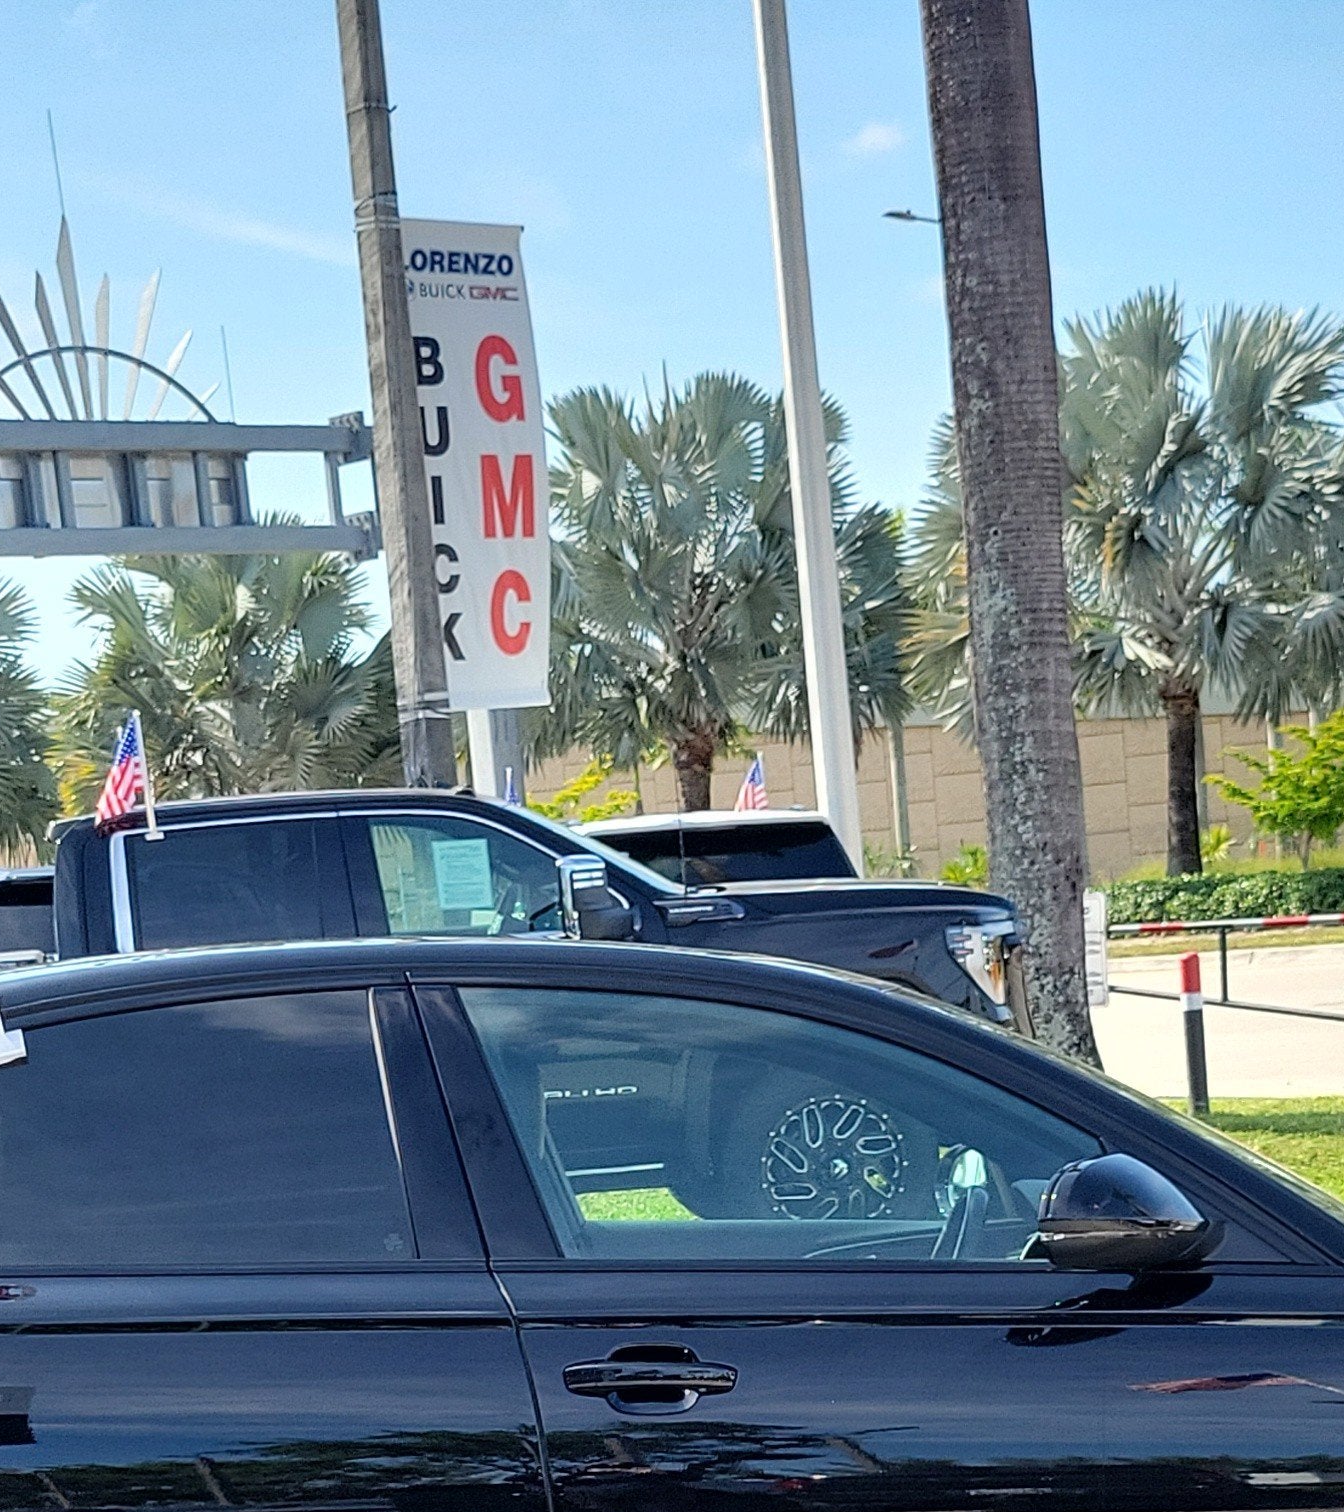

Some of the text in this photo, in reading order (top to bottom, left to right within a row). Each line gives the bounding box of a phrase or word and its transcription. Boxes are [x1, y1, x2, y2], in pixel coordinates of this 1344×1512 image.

[405, 249, 514, 277] ORENZO
[419, 283, 519, 301] BUICK GMC
[475, 334, 535, 656] GMC
